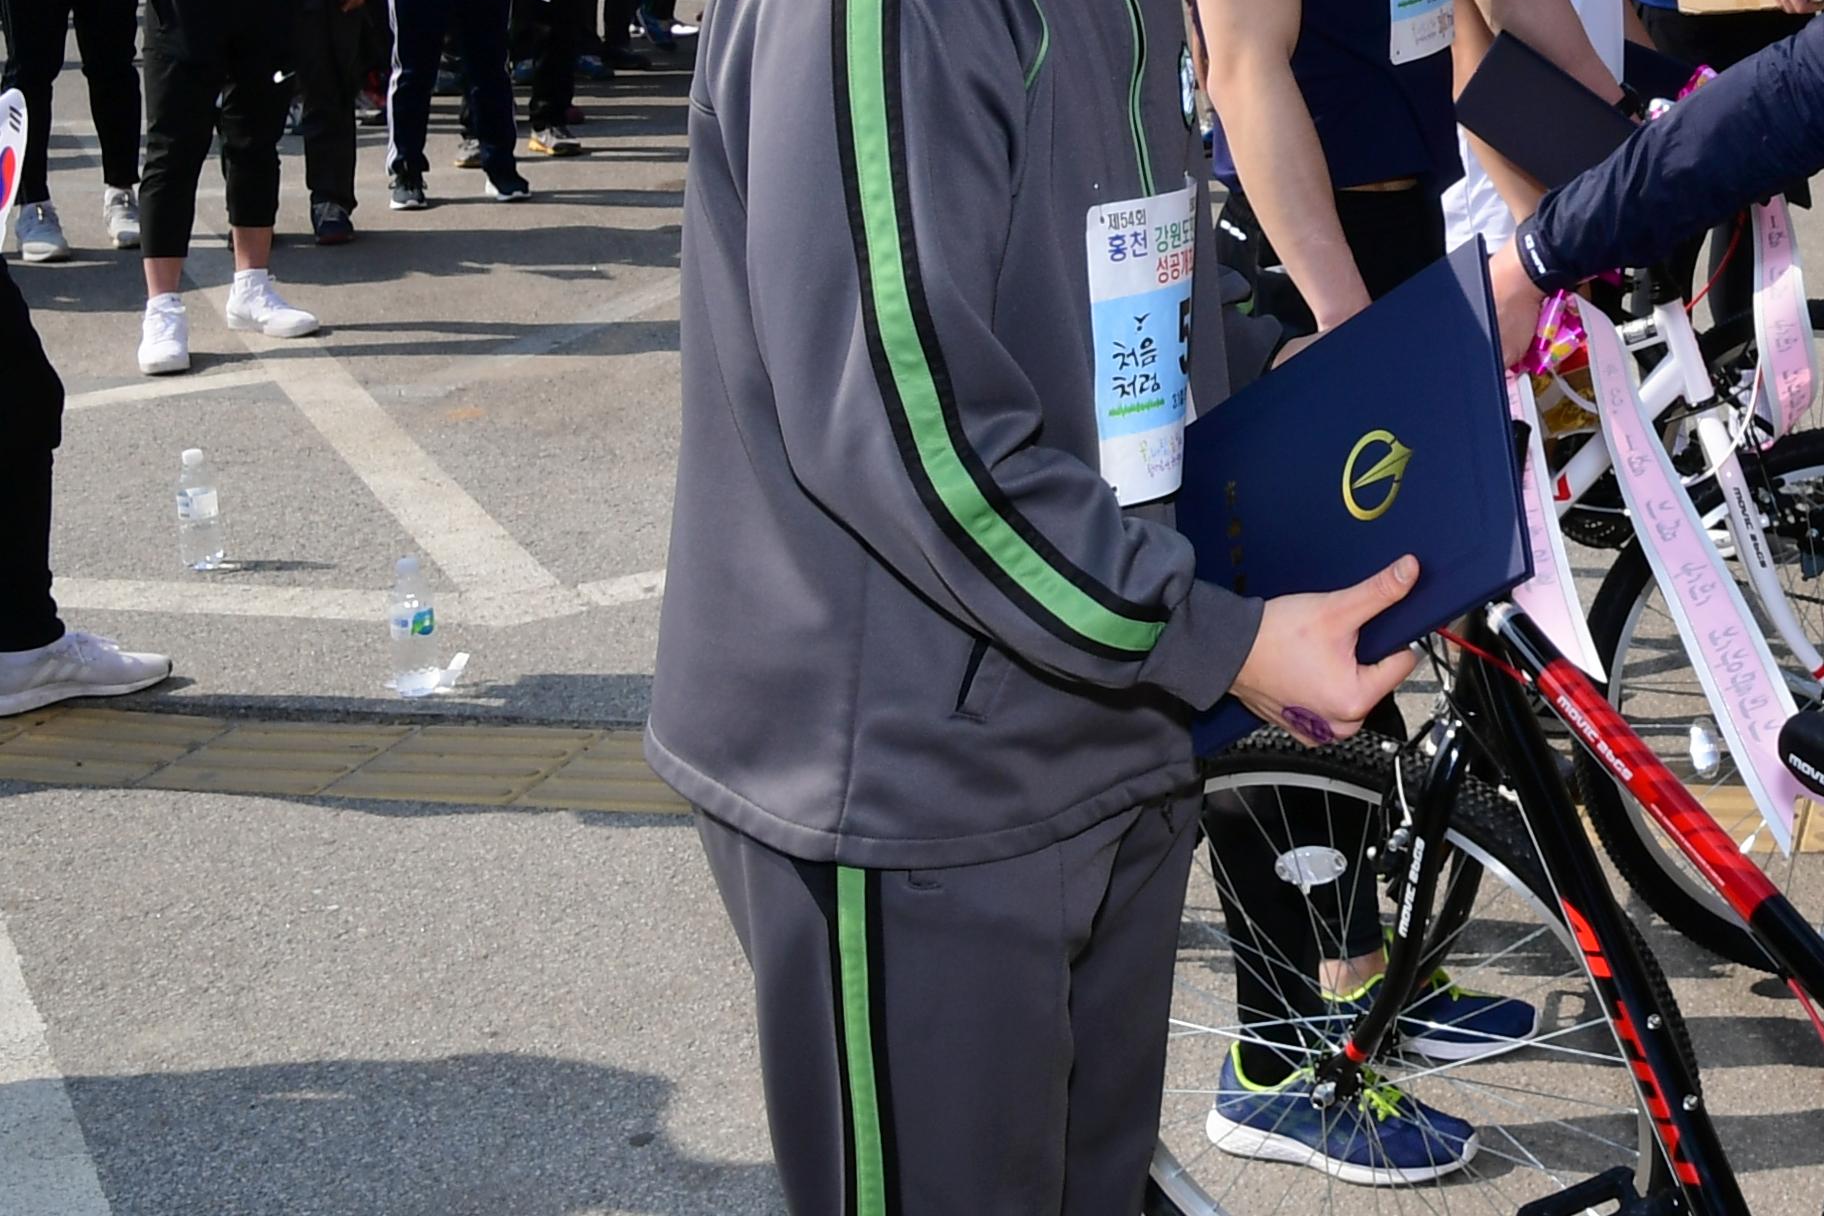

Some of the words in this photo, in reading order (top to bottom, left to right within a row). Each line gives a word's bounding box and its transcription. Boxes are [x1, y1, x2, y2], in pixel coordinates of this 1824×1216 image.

[1108, 208, 1147, 231] 제54회
[1108, 229, 1148, 262] 홍천
[1112, 337, 1158, 371] 처음
[1112, 373, 1161, 399] 처럼
